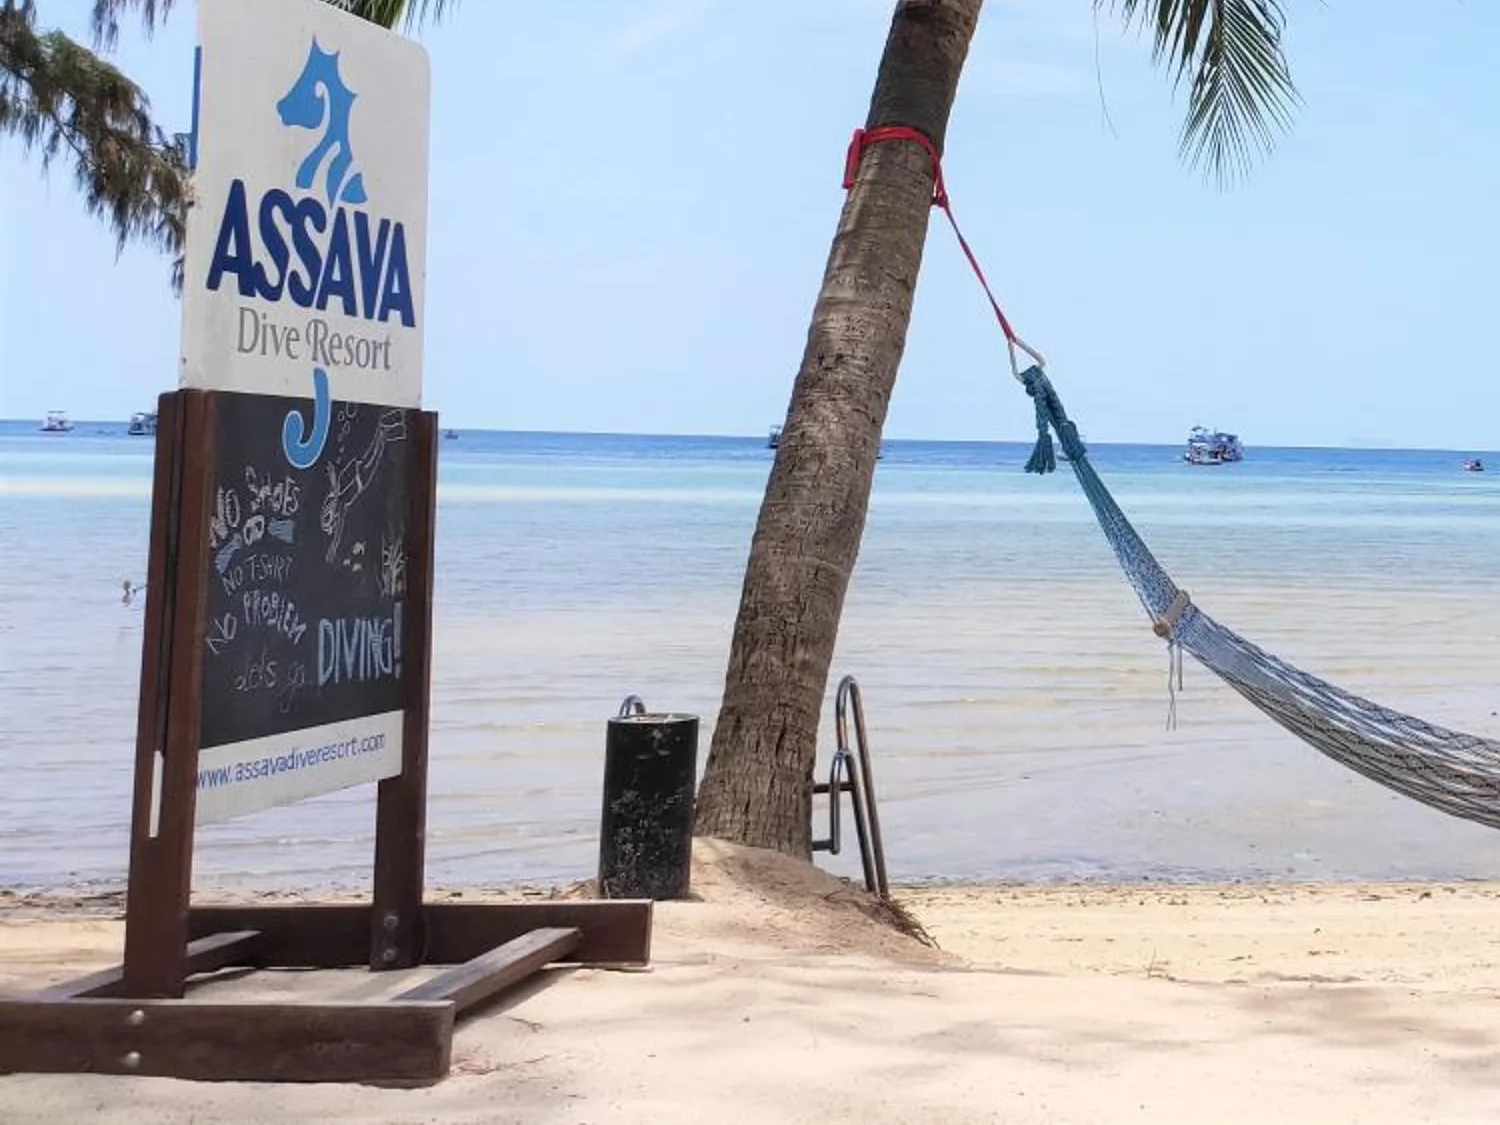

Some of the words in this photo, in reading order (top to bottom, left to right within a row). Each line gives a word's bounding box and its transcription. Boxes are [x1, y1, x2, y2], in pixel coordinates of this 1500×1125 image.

[205, 178, 416, 328] ASSAVA
[237, 306, 300, 361] Dive
[306, 319, 391, 372] Resort
[209, 486, 240, 548] NO
[221, 565, 243, 597] NO
[206, 613, 237, 655] NO
[318, 601, 402, 687] DIVING!
[196, 731, 386, 789] www.assavadiveresort.com
